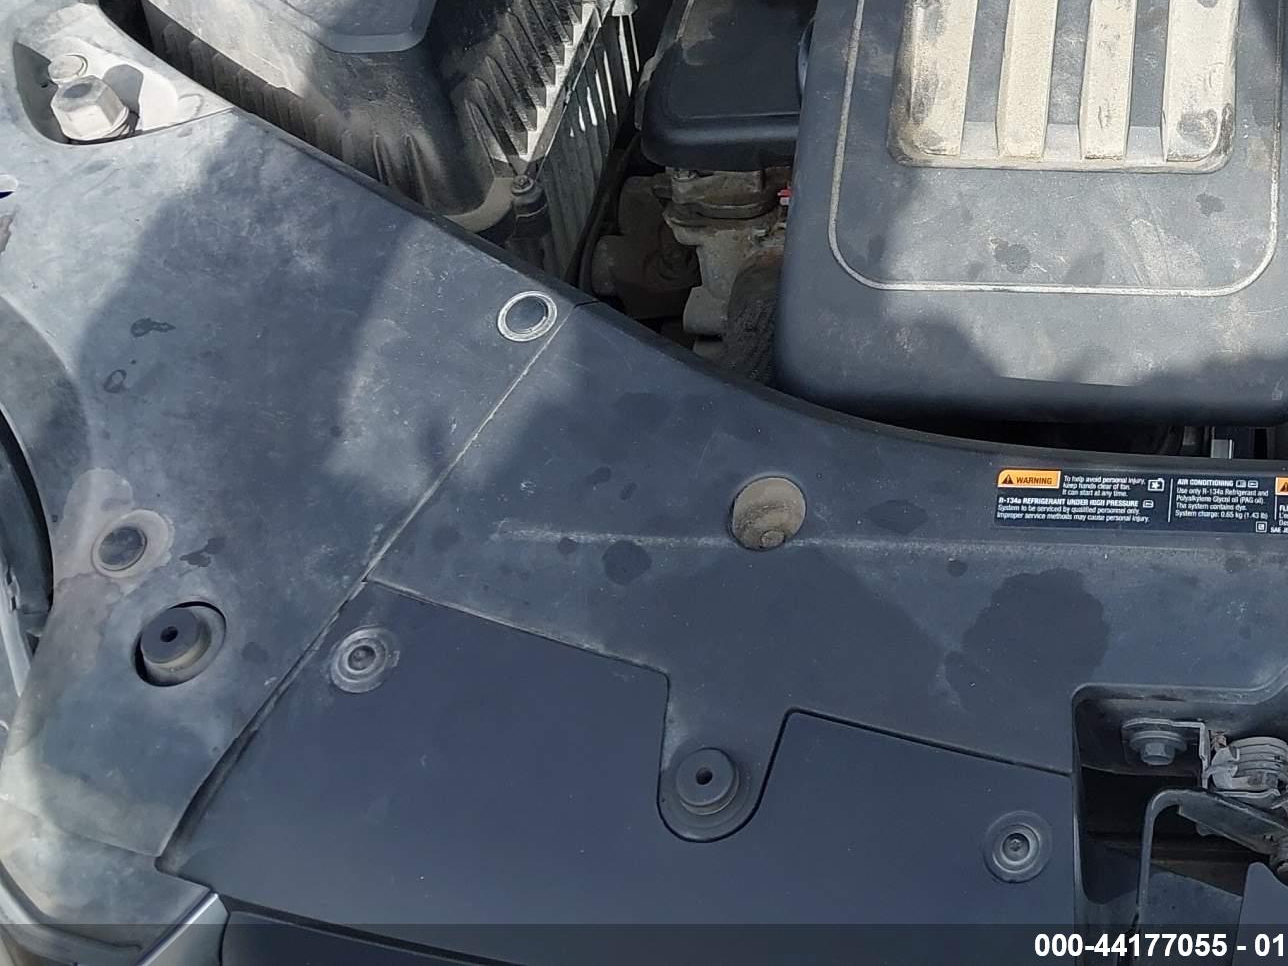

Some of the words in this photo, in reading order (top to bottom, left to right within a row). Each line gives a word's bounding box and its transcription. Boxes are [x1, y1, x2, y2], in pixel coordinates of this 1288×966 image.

[1017, 477, 1052, 485] WARNING
[1224, 489, 1257, 497] Refrigerant
[996, 512, 1024, 520] Improper
[1175, 510, 1197, 518] System
[1198, 510, 1220, 518] charge:
